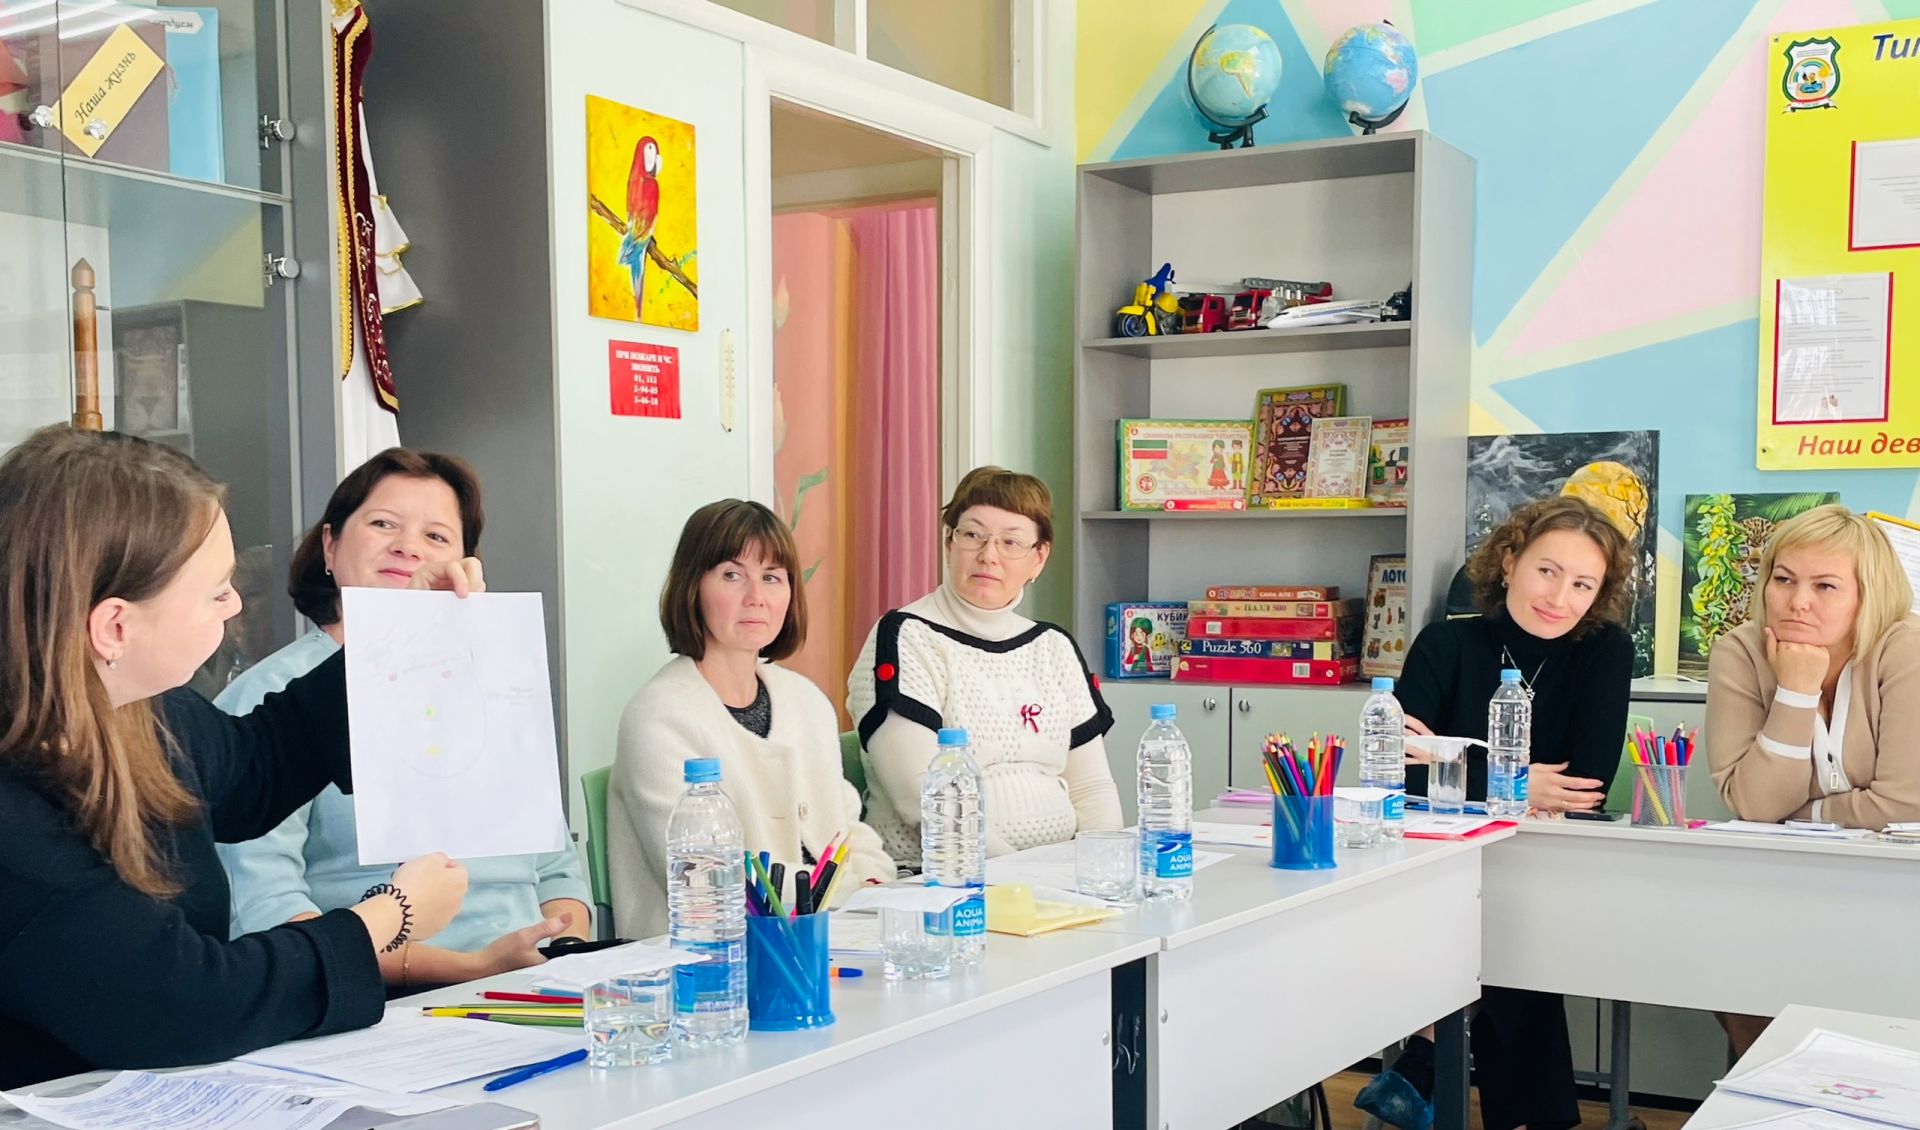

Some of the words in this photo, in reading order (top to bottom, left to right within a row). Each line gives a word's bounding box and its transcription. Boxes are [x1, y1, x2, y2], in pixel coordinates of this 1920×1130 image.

[74, 86, 106, 125] Наша
[105, 52, 136, 90] жизнь
[1798, 435, 1862, 456] Наш
[1871, 432, 1920, 454] дев
[1202, 640, 1237, 654] Puzzle
[1240, 640, 1262, 654] 560
[955, 907, 983, 919] AQUA
[955, 917, 983, 928] ANIMA
